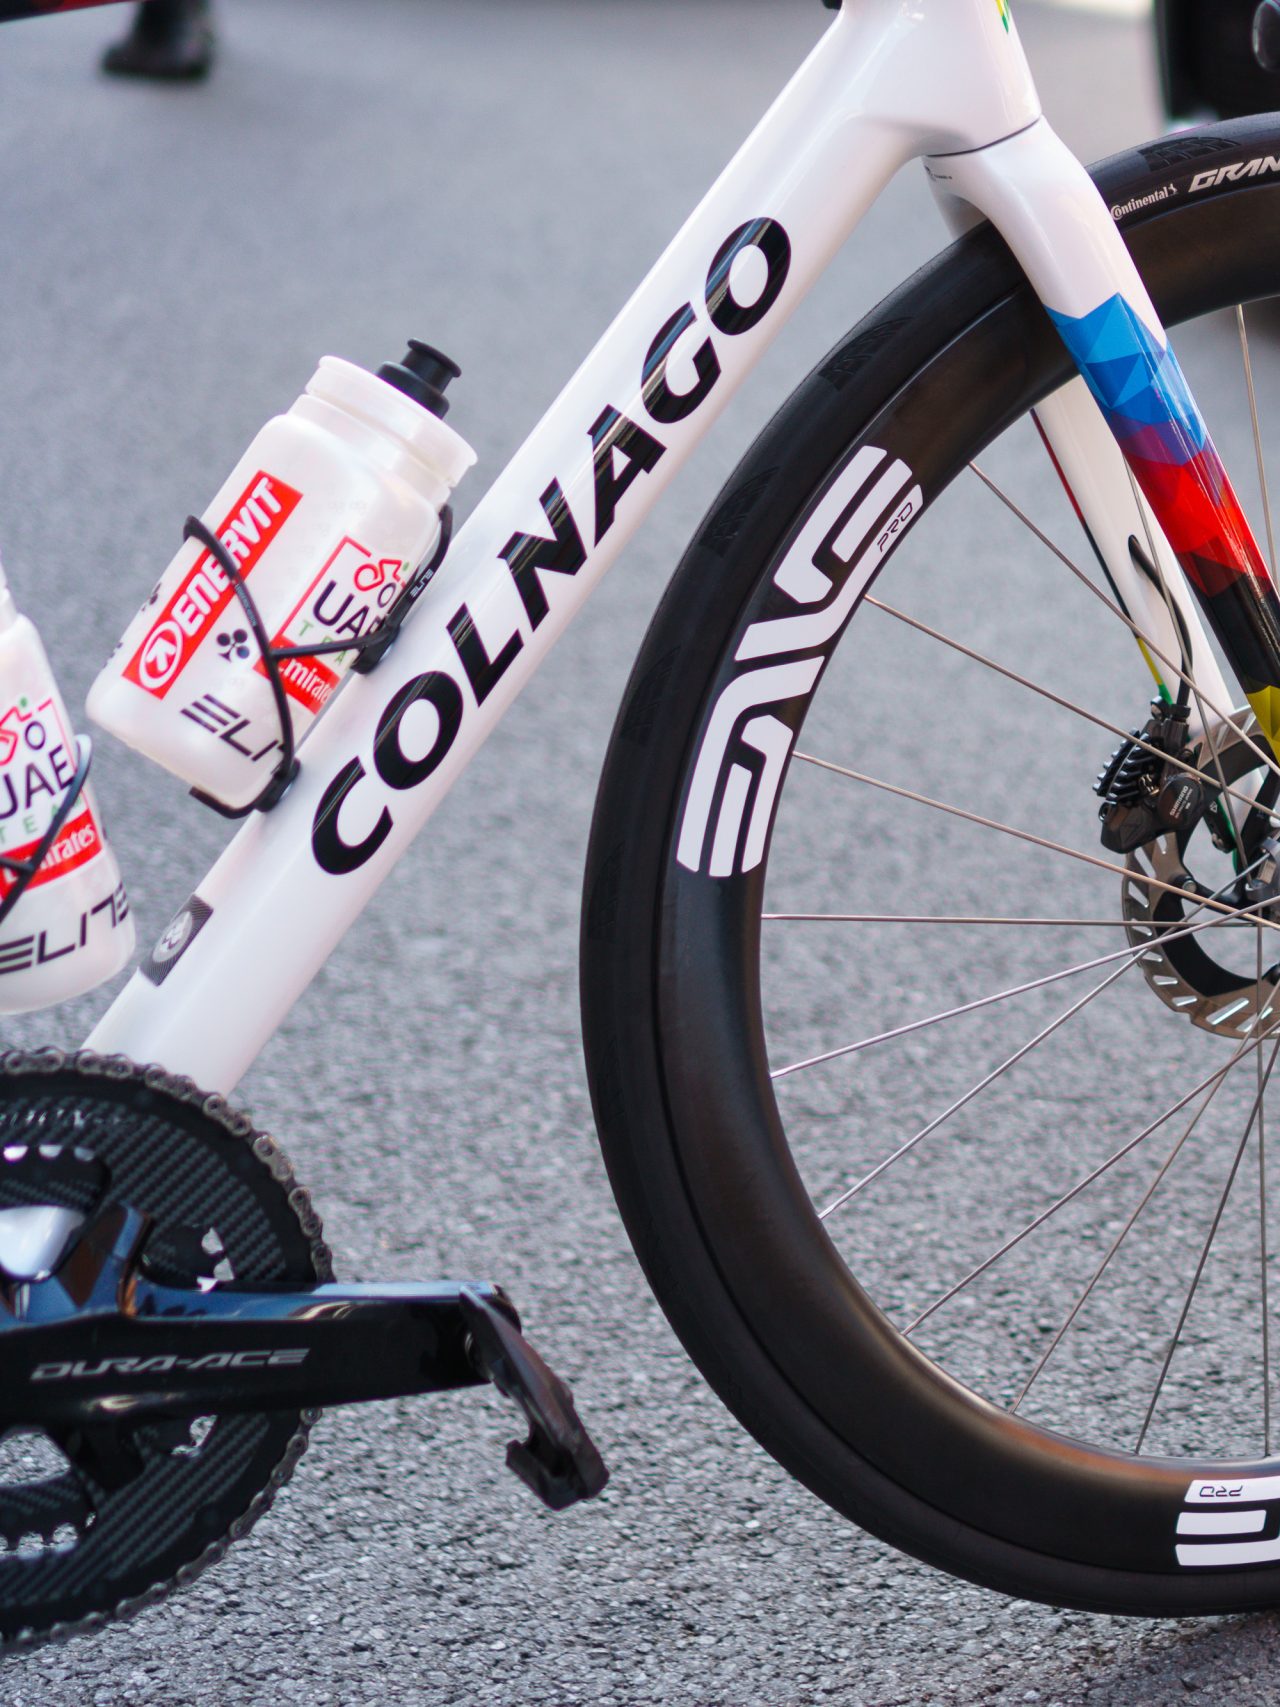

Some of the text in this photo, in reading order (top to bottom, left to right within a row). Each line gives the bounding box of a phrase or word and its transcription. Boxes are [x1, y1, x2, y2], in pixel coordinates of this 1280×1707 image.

[1111, 183, 1169, 221] Continental
[171, 477, 282, 637] ENERVIT
[312, 216, 791, 875] COLNAGO
[877, 502, 913, 552] PRO
[676, 445, 923, 878] ENVE
[180, 693, 285, 761] ELI
[0, 744, 75, 820] UAE
[0, 880, 129, 975] ELITE
[30, 1348, 310, 1381] DURA-ACE
[1200, 1484, 1244, 1498] PRO
